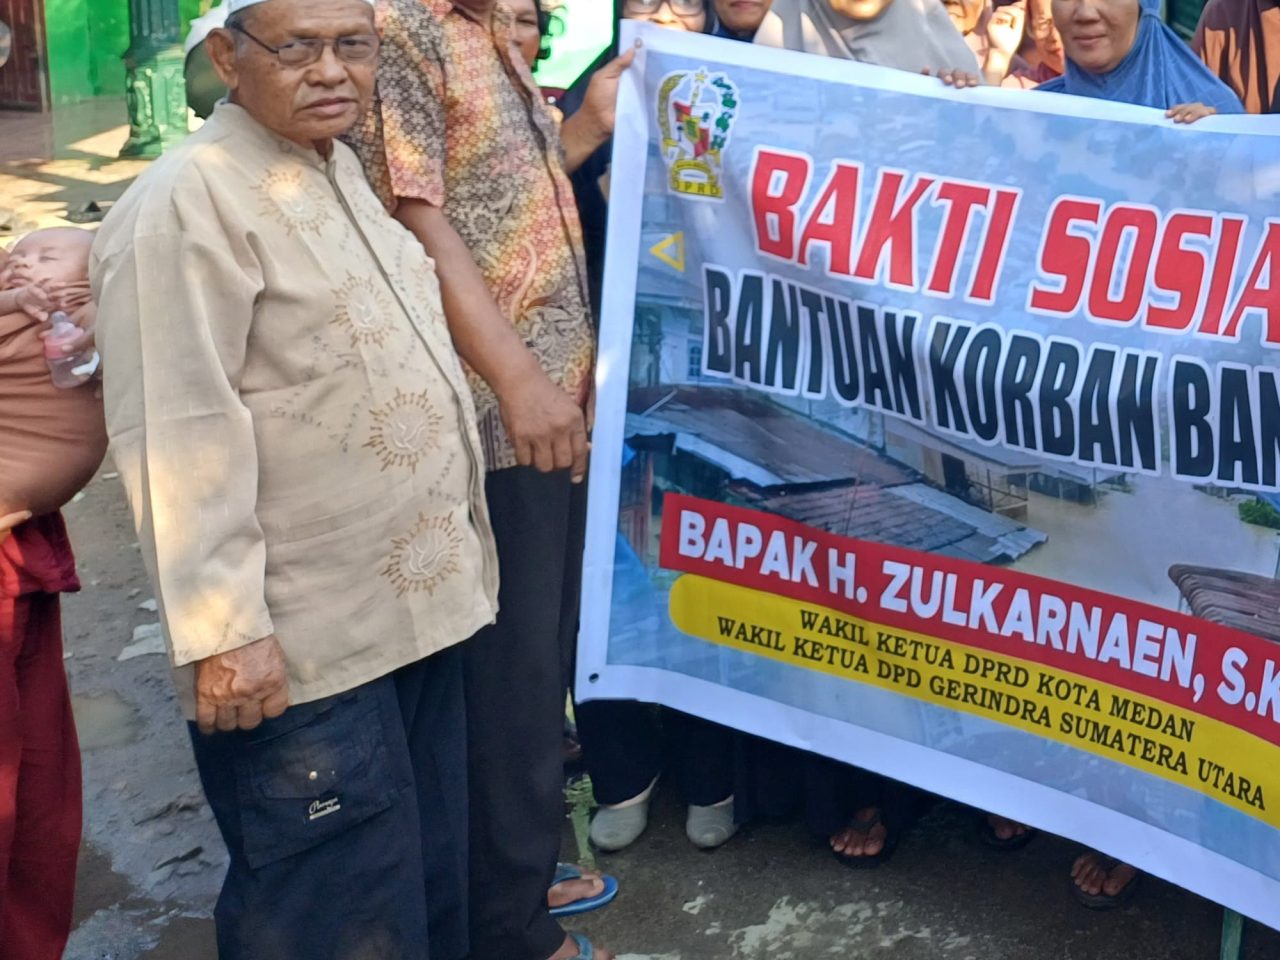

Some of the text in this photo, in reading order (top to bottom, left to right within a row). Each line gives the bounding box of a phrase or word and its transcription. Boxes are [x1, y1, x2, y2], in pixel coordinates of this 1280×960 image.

[752, 150, 1018, 301] BAKTI
[703, 266, 924, 421] BANTUAN
[929, 323, 1158, 471] KORBAN
[678, 509, 819, 588] BAPAK
[828, 548, 868, 604] H.
[880, 559, 1206, 703] ZULKARNAEN,
[800, 609, 1196, 742] WAKIL KETUA DPRD KOTA MEDAN
[717, 616, 1266, 811] WAKIL KETUA DPD GERINDRA SUMATERA UTARA
